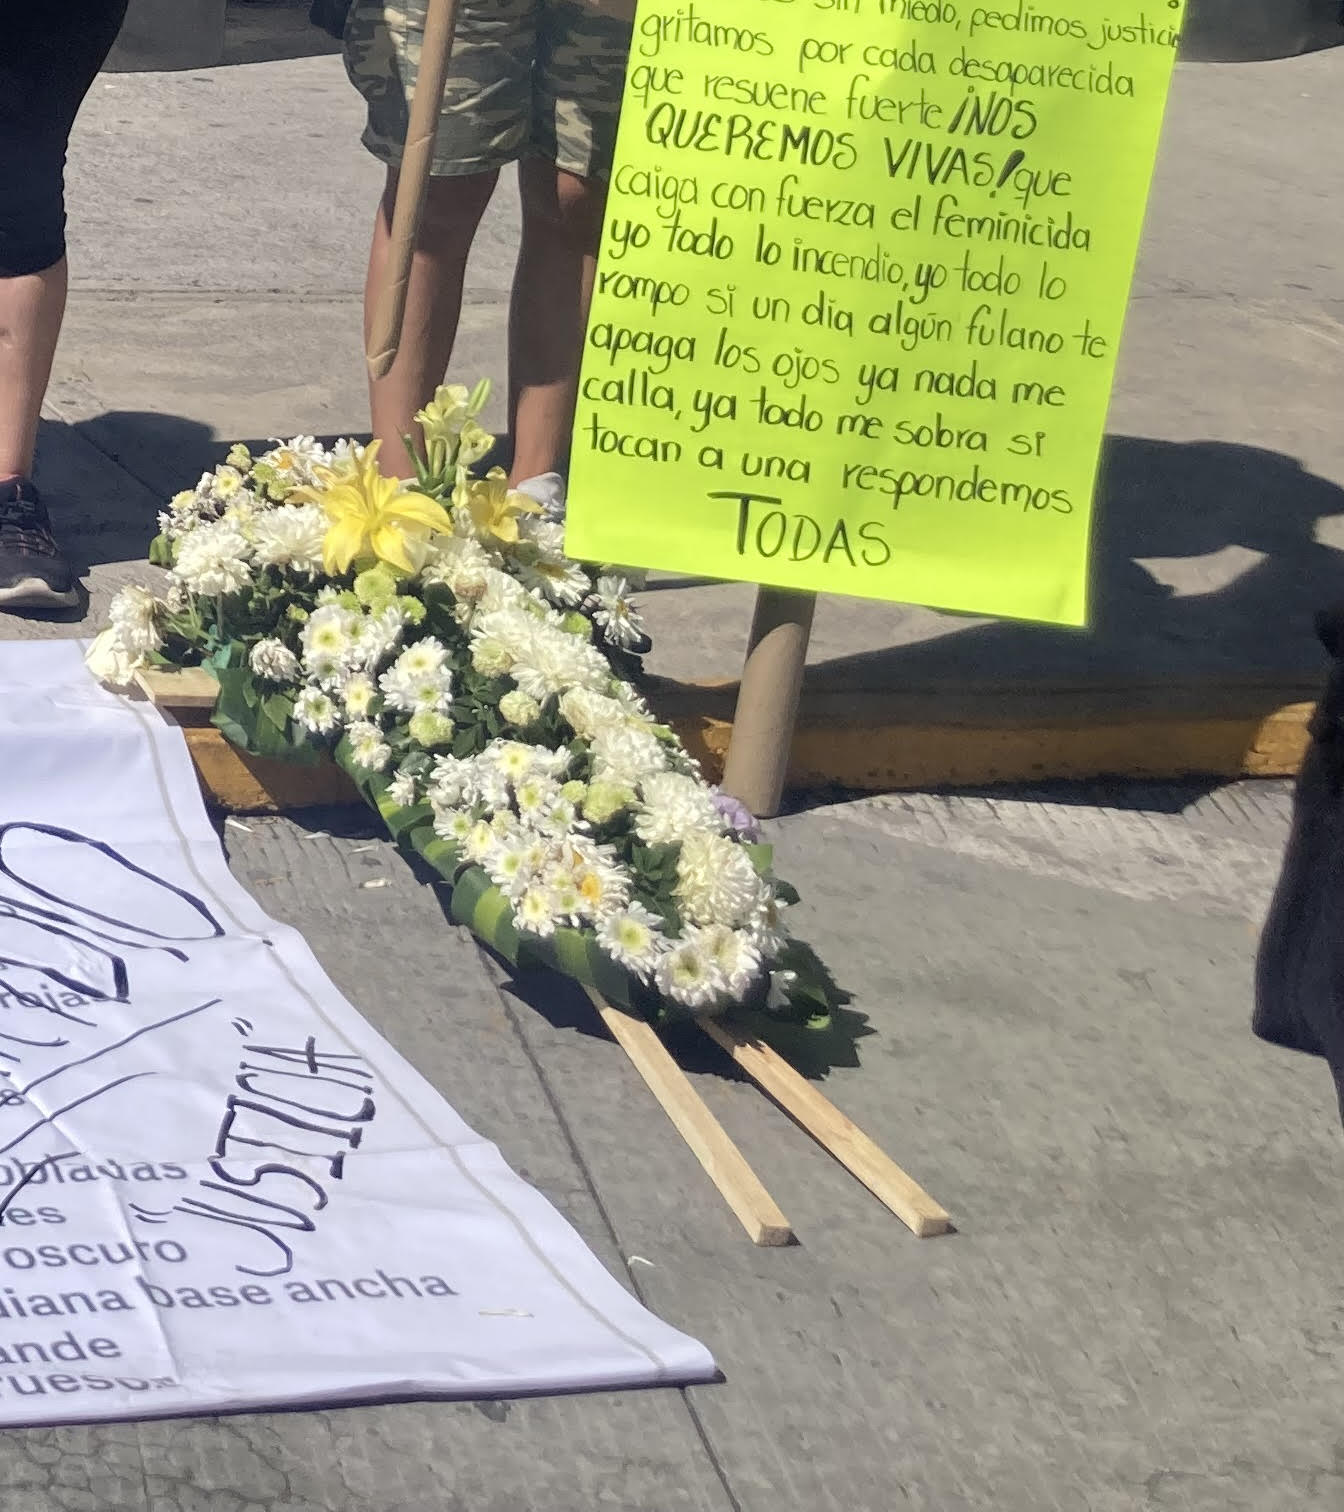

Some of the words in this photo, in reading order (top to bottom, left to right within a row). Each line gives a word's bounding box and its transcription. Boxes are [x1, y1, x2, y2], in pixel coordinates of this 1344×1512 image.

[970, 0, 1087, 41] pedimos
[641, 3, 774, 57] gritamos
[949, 42, 1134, 97] desaparecida
[704, 73, 827, 116] resuene
[846, 74, 945, 130] fuerte
[645, 102, 857, 170] QUEREMOS
[776, 174, 875, 229] fuerza
[933, 198, 1091, 251] feminicida
[966, 305, 1063, 356] fulano
[841, 461, 1073, 514] respondemos
[8, 1237, 189, 1270] oscuro
[151, 1278, 274, 1313] base
[289, 1270, 459, 1303] ancha
